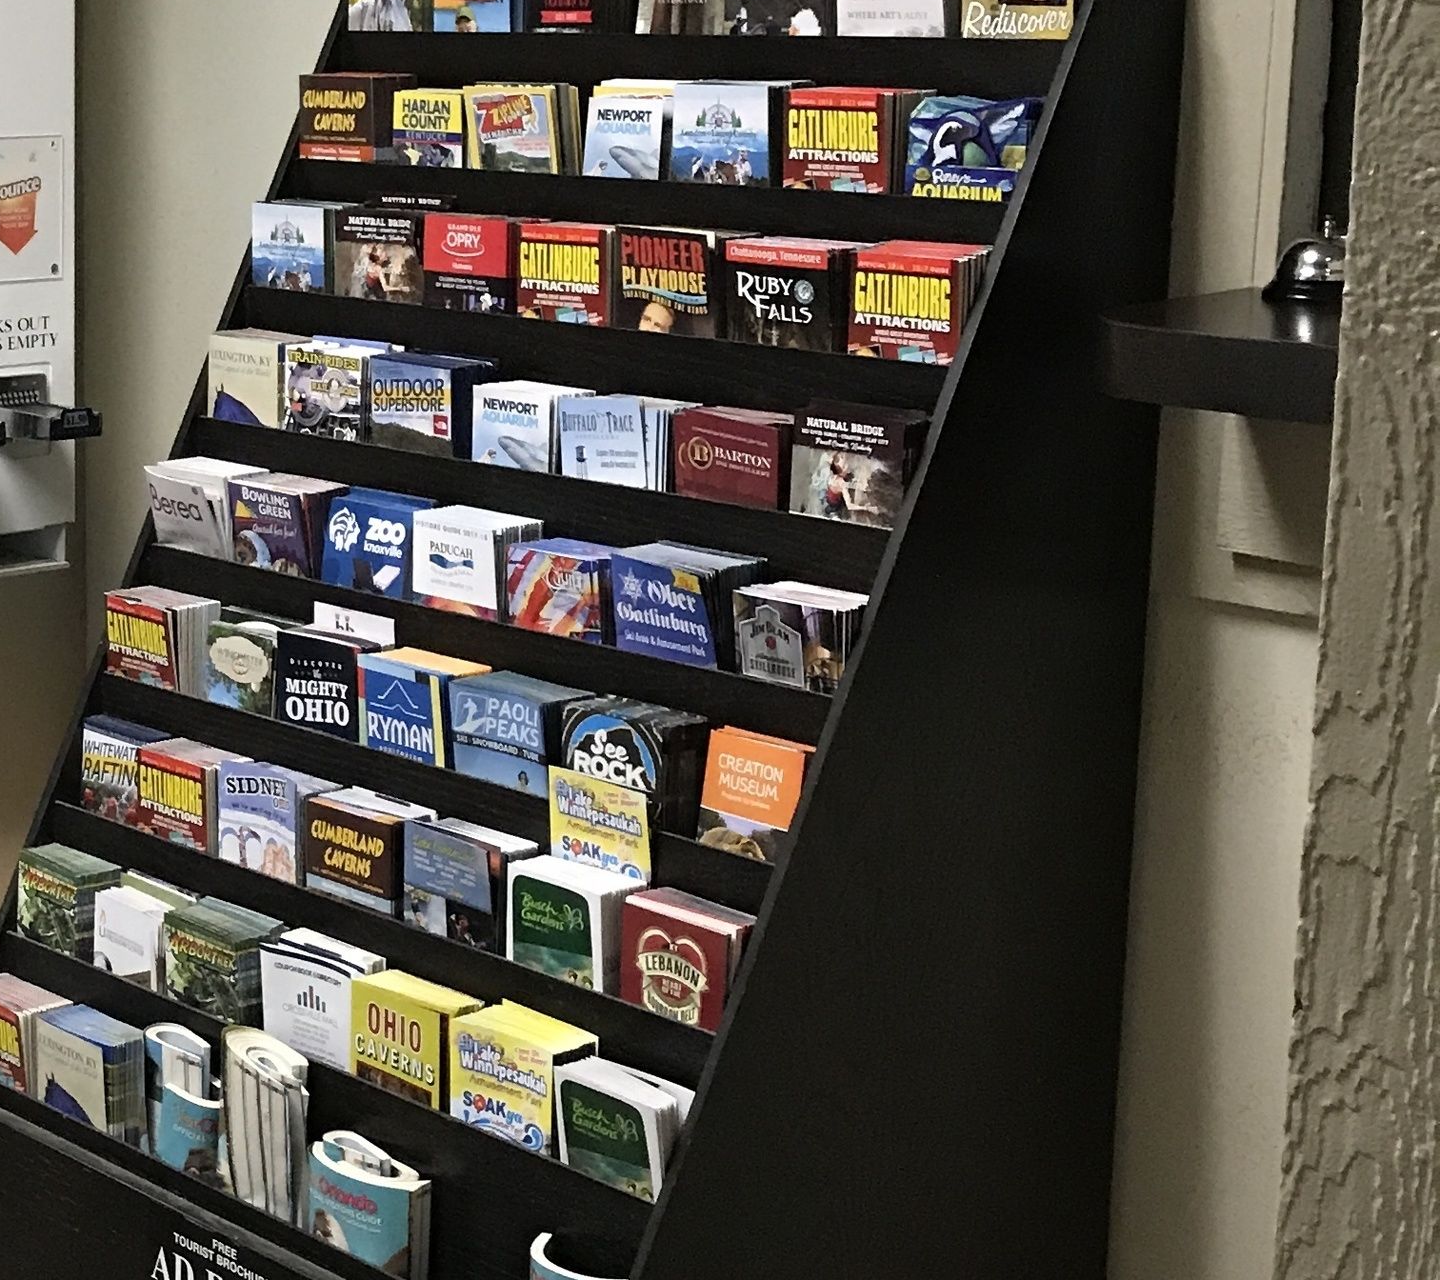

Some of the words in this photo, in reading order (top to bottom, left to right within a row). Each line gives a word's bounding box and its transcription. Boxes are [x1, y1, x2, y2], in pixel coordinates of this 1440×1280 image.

[963, 1, 1071, 39] Rediscover
[303, 89, 366, 109] CUMBERLAND
[402, 98, 450, 115] HARLAN
[314, 113, 356, 132] CAVERNS
[402, 114, 450, 131] COUNTY
[598, 108, 652, 123] NEWPORT
[596, 122, 652, 136] AQUARIUM
[788, 109, 878, 151] GATLINBURG
[788, 148, 879, 163] ATTRACTIONS
[348, 216, 386, 227] NATURAL
[446, 231, 482, 249] OPRY
[520, 241, 599, 282] GATLINBURG
[621, 234, 704, 272] PIONEER
[780, 249, 821, 264] Tennessee
[520, 279, 599, 295] ATTRACTIONS
[622, 265, 707, 295] PLAYHOUSE
[736, 271, 794, 300] RUBY
[855, 271, 950, 321] GATLINBURG
[755, 295, 813, 324] FALLS
[17, 315, 50, 332] OUT
[855, 313, 950, 333] ATTRACTIONS
[8, 332, 59, 351] EMPTY
[288, 349, 321, 364] TRAIN
[373, 378, 445, 397] OUTDOOR
[374, 397, 445, 413] SUPERSTORE
[483, 397, 539, 416] NEWPORT
[483, 410, 539, 429] AQUARIUM
[562, 411, 597, 432] BUFFALO
[605, 411, 634, 433] TRACE
[806, 417, 849, 432] NATURAL
[851, 423, 884, 437] BRIDGE
[714, 446, 771, 469] BARTON
[149, 483, 203, 521] Berea
[241, 486, 289, 508] BOWLING
[258, 503, 292, 520] GREEN
[364, 540, 403, 560] knoxville
[429, 540, 473, 559] PADUCAH
[648, 580, 696, 613] Ober
[617, 602, 708, 643] Gatlinburg
[109, 642, 169, 667] ATTRACTIONS
[289, 657, 343, 670] DISCOVER
[285, 677, 349, 700] MIGHTY
[285, 696, 350, 727] OHIO
[487, 696, 540, 727] PAOLI
[367, 710, 434, 754] RYMAN
[485, 716, 540, 747] PEAKS
[456, 734, 468, 744] SKI
[472, 737, 518, 755] SNOWBOARD
[590, 729, 630, 762] See
[573, 751, 647, 792] ROCK
[718, 753, 783, 783] CREATION
[140, 764, 202, 815] GATLINBURG
[226, 777, 286, 798] SIDNEY
[568, 786, 592, 806] Lake
[141, 798, 202, 827] ATTRACTIONS
[311, 820, 384, 858] CUMBERLAND
[324, 847, 371, 878] CAVERNS
[520, 891, 554, 915] Busch
[521, 907, 564, 931] Gardens
[645, 955, 700, 987] LEBANON
[367, 1002, 422, 1053] OHIO
[355, 1033, 435, 1084] CAVERNS
[474, 1041, 501, 1061] Lake
[572, 1097, 610, 1123] Busch
[572, 1111, 619, 1139] Gardens
[173, 1231, 215, 1262] TOURIST
[212, 1238, 238, 1261] FREE
